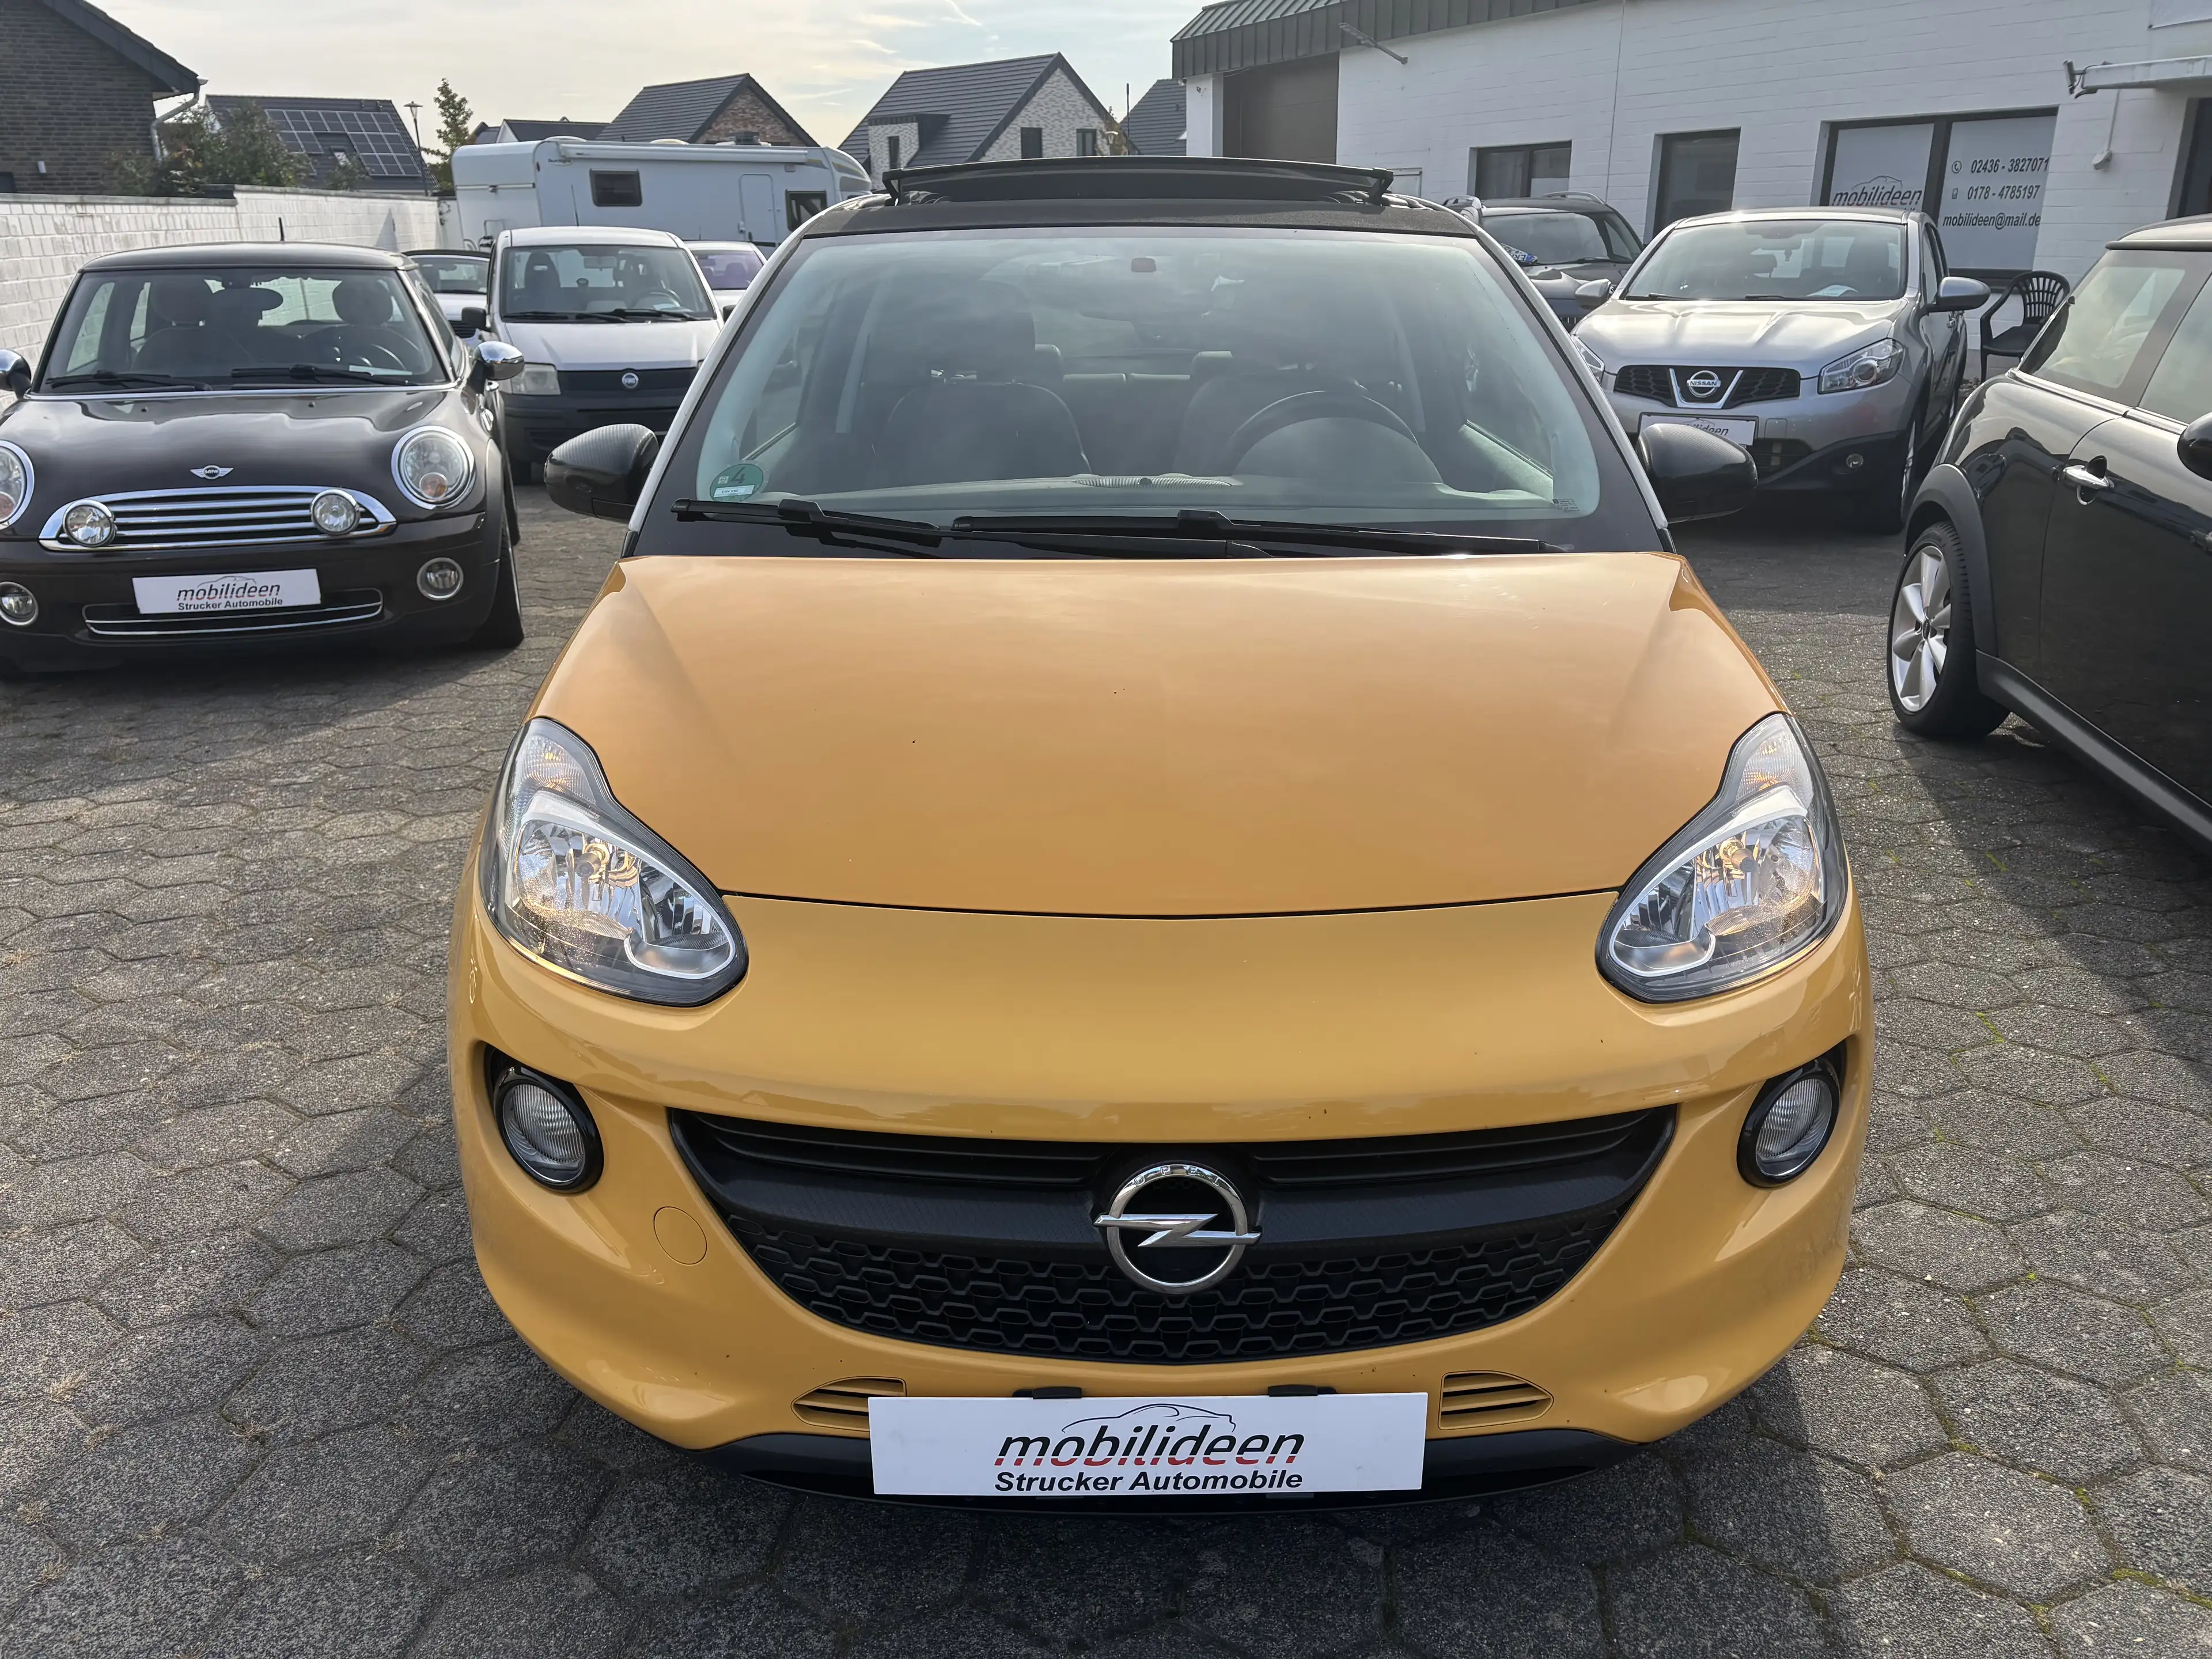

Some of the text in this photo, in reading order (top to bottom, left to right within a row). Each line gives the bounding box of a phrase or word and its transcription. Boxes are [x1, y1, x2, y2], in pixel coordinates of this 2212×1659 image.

[1971, 160, 1999, 173] 02436
[2008, 157, 2050, 172] 3827071
[1832, 185, 1923, 206] mobilideen
[1967, 186, 1990, 200] 0178
[1998, 184, 2040, 199] 4785197
[1942, 213, 2041, 230] mobilideen@mail.de
[730, 467, 746, 484] 4
[177, 582, 280, 601] mobilideen
[178, 597, 282, 610] Strucker Automobile
[994, 1423, 1305, 1467] mobilideen
[994, 1469, 1302, 1492] Strucker Automobile
